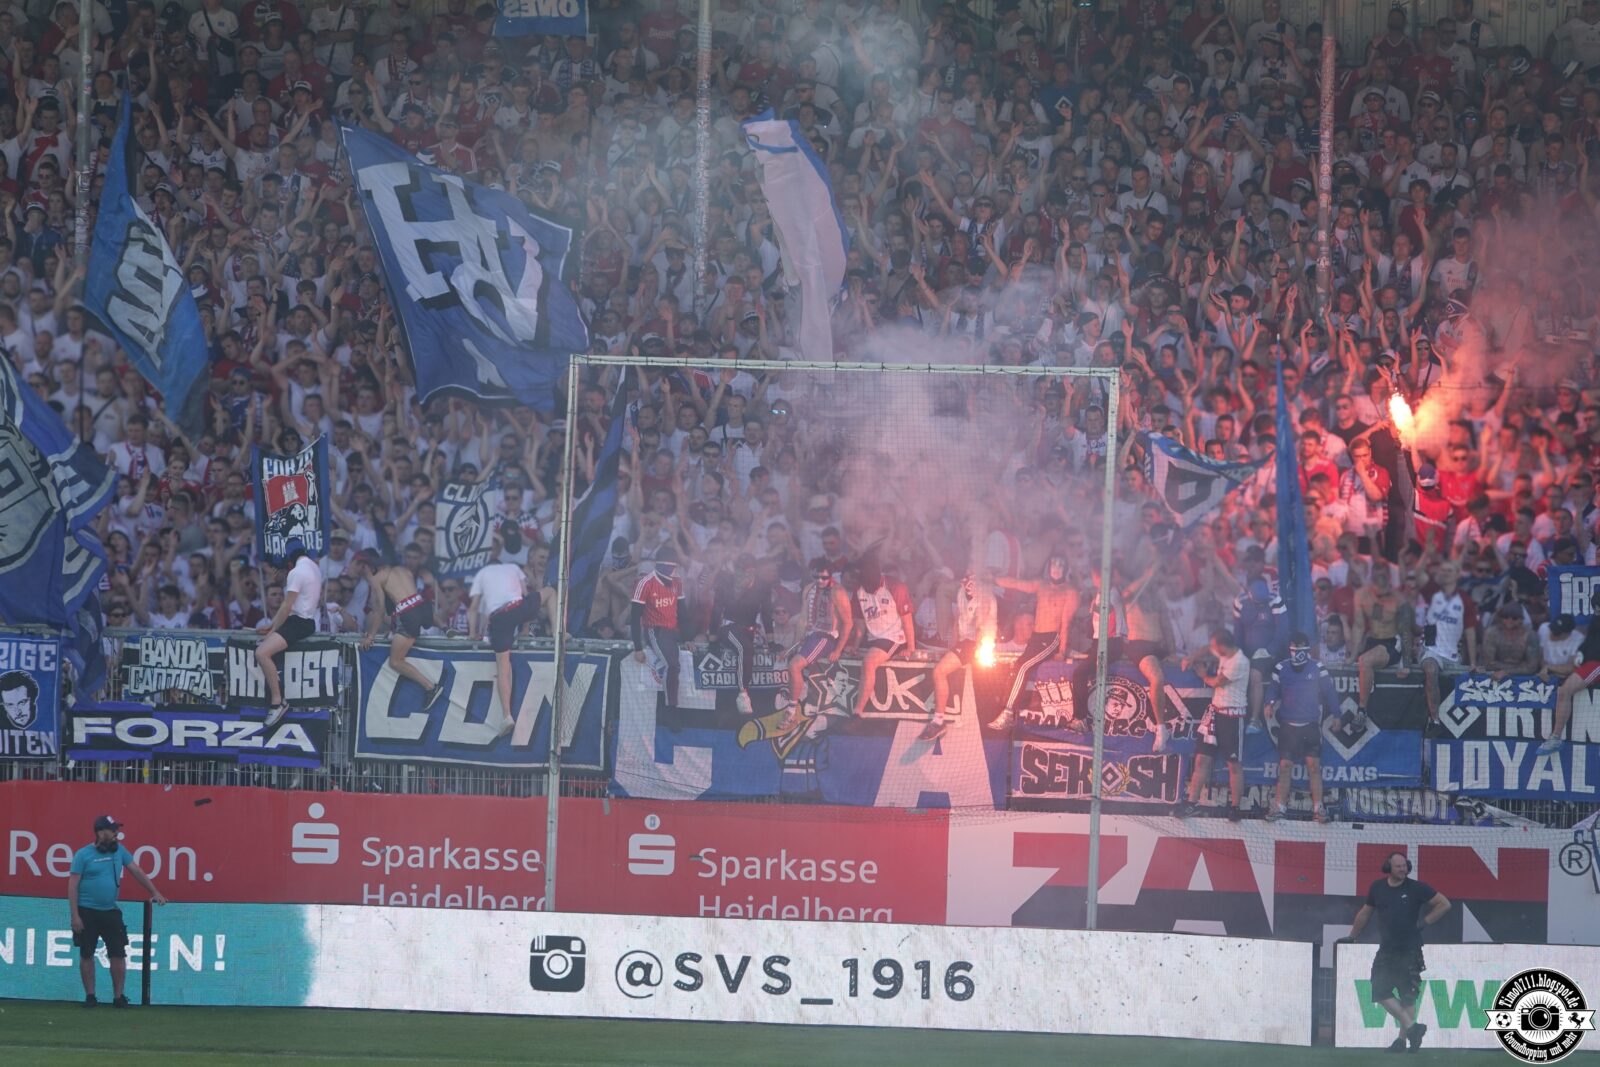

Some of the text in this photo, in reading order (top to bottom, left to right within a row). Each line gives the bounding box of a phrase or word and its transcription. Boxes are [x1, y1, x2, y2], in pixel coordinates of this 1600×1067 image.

[655, 596, 676, 608] HSV
[141, 637, 207, 670] BANDA
[283, 649, 340, 699] OST
[73, 717, 316, 752] FORZA
[361, 836, 541, 875] Sparkasse
[697, 847, 879, 887] Sparkasse
[614, 949, 976, 1005] @SVS_1916
